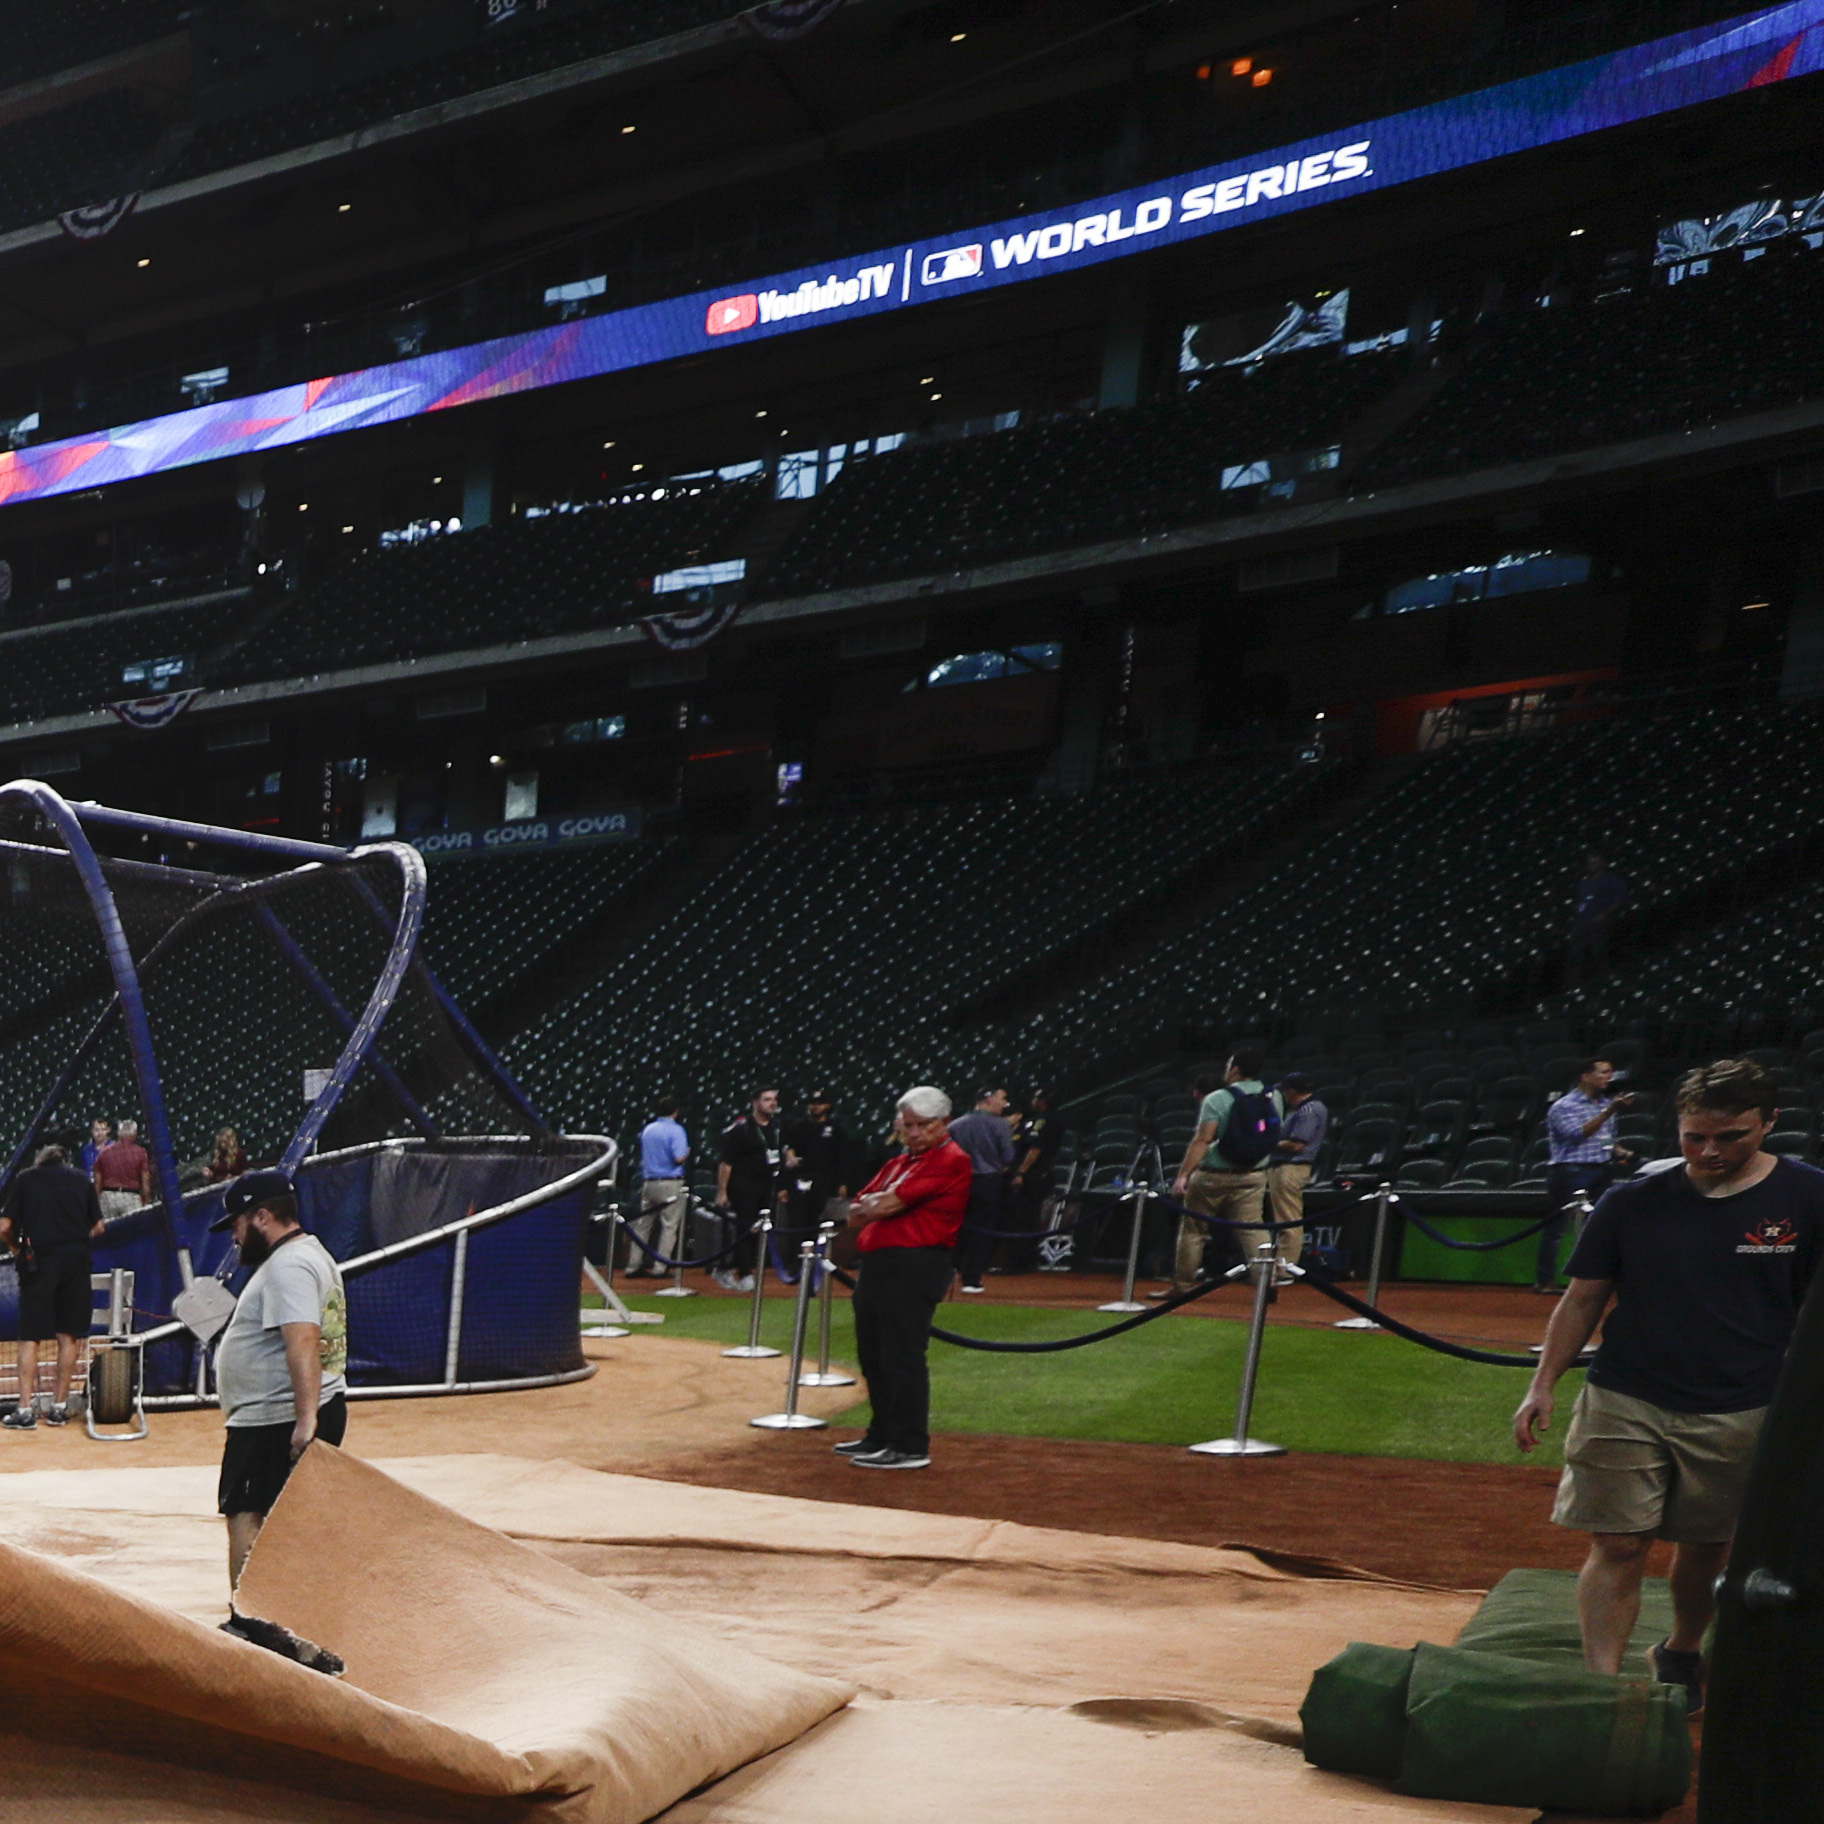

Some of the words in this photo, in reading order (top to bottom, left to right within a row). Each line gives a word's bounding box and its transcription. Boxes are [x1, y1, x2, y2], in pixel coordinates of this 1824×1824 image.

[757, 262, 895, 324] YouTubeTV
[990, 196, 1172, 271] WORLD
[1178, 140, 1371, 224] SERIES
[483, 825, 549, 846] GOYA
[559, 813, 627, 836] GOYA
